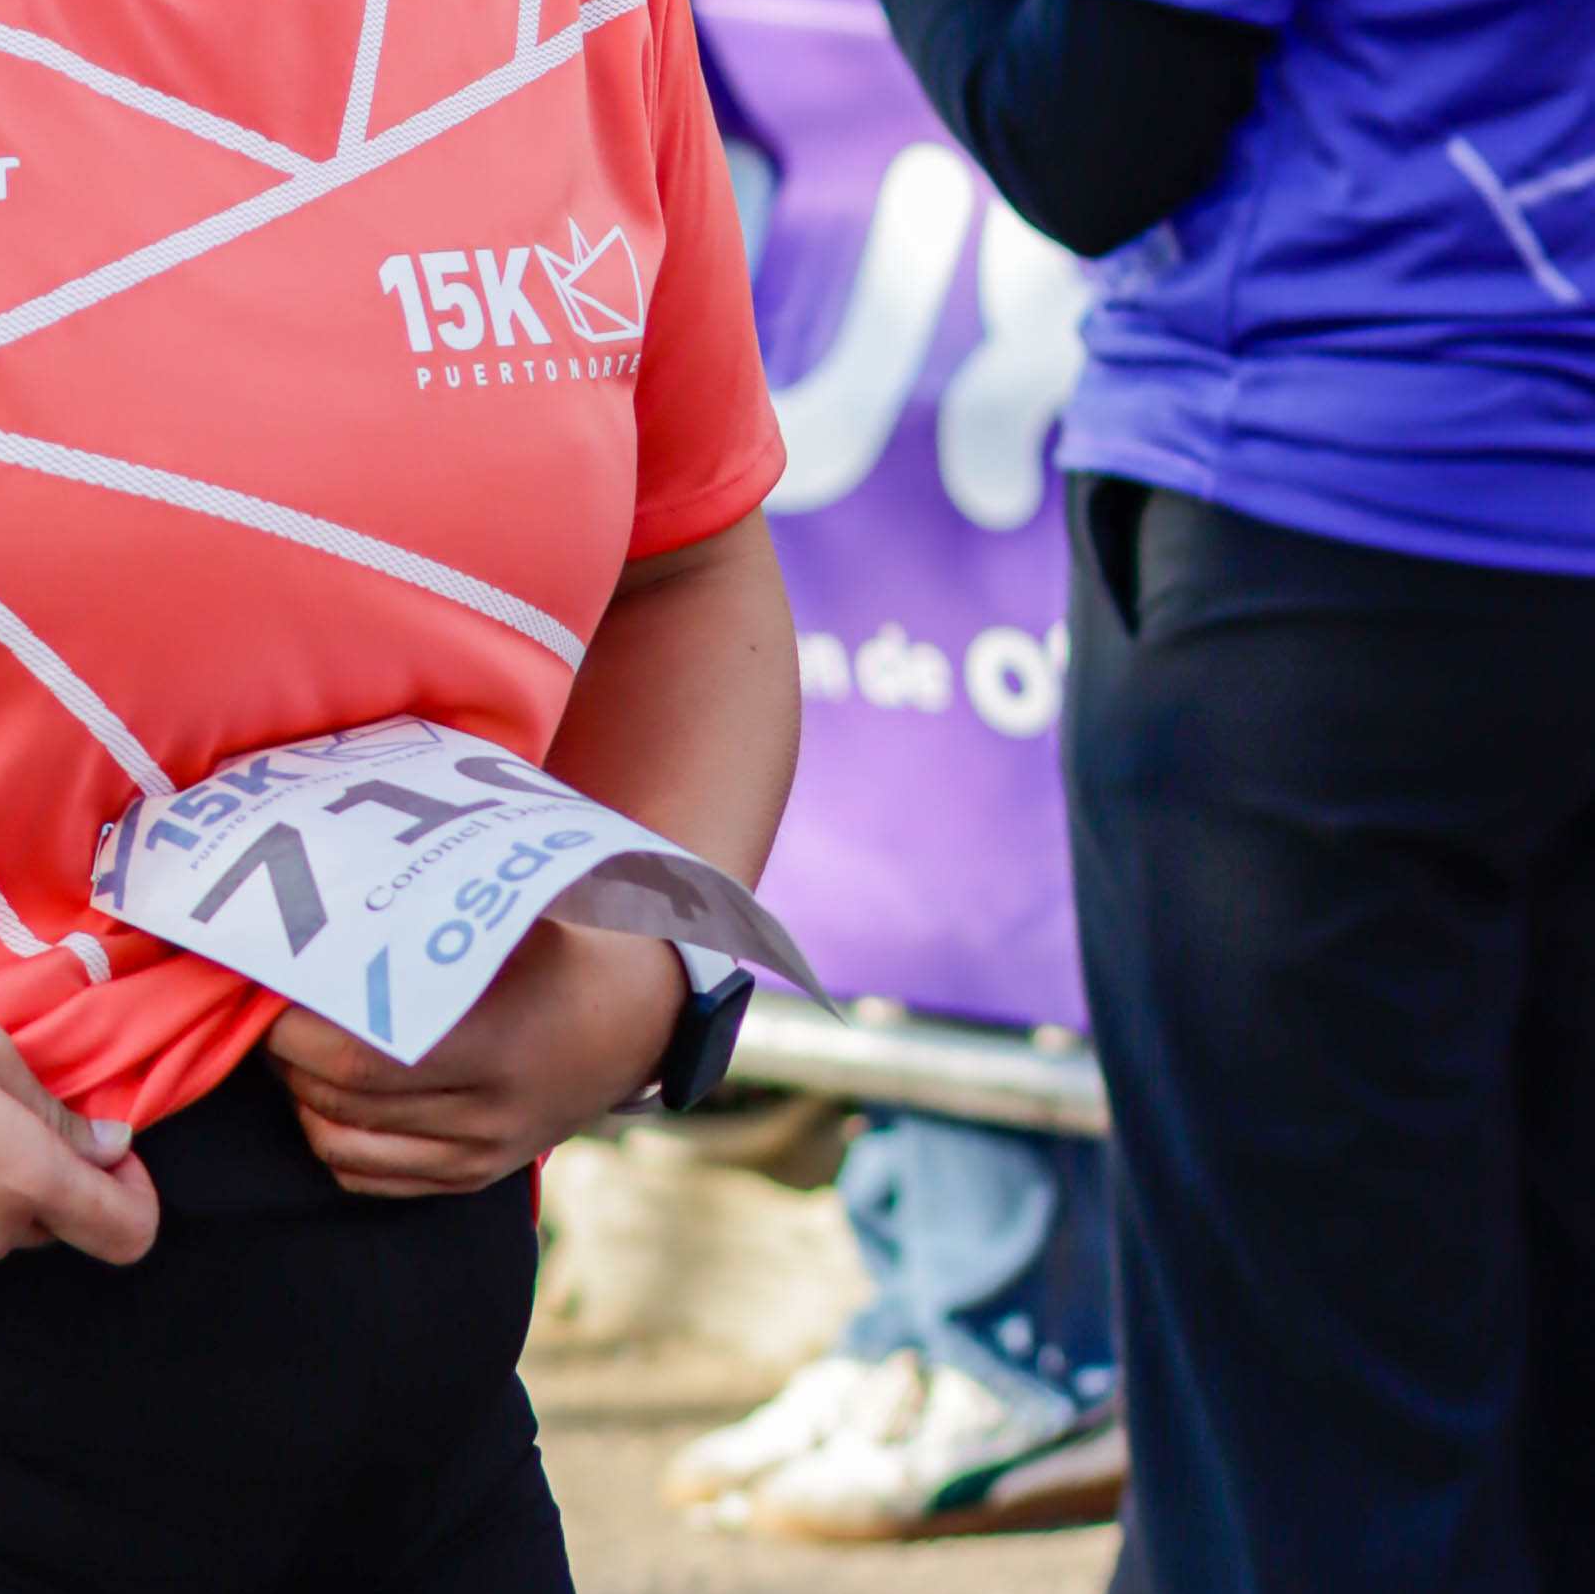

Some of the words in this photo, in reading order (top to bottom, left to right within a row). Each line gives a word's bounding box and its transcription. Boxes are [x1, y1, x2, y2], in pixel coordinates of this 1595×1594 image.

[377, 246, 553, 353] 15K
[416, 358, 558, 390] PUERTO
[567, 352, 642, 381] NORTE
[145, 754, 311, 852] 15K
[364, 819, 493, 912] Coronel
[424, 828, 597, 966] osde
